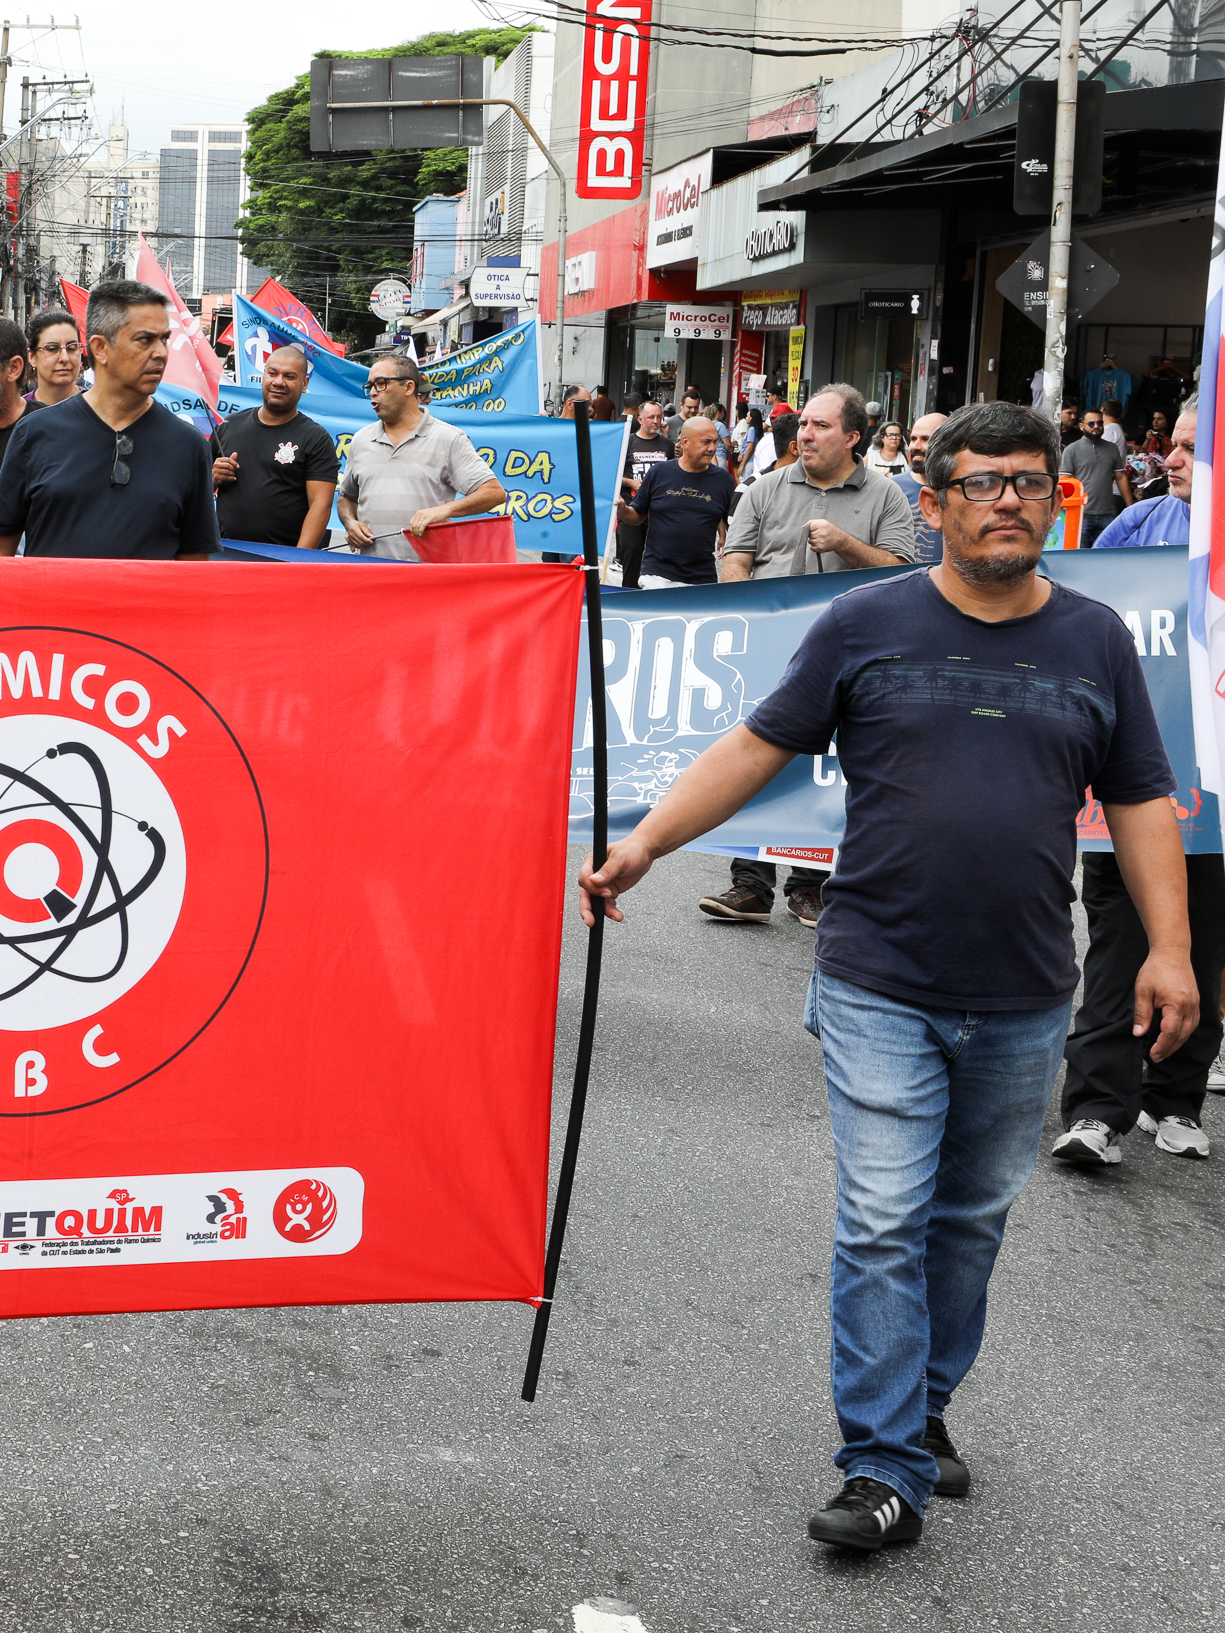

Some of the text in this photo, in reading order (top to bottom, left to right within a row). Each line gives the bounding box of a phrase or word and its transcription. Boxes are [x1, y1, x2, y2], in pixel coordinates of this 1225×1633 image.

[655, 173, 701, 221] MicroCel
[486, 273, 510, 282] ÓTICA
[474, 292, 521, 300] SUPERVISÃO
[669, 312, 730, 324] MicroCel
[742, 303, 797, 330] Preço Atacado
[300, 340, 321, 358] ABC
[456, 332, 525, 364] IMPOSTO
[461, 356, 504, 380] PARA
[163, 398, 241, 414] DSADE
[506, 451, 554, 483] DA
[771, 846, 830, 862] BANCÁRIOS-CUT
[115, 1192, 127, 1202] SP
[289, 1193, 309, 1203] ICM
[41, 1241, 68, 1249] Federação
[81, 1239, 115, 1247] Trabalhadores
[140, 1236, 161, 1244] Químico
[95, 1246, 106, 1254] São
[106, 1246, 121, 1254] Paulo
